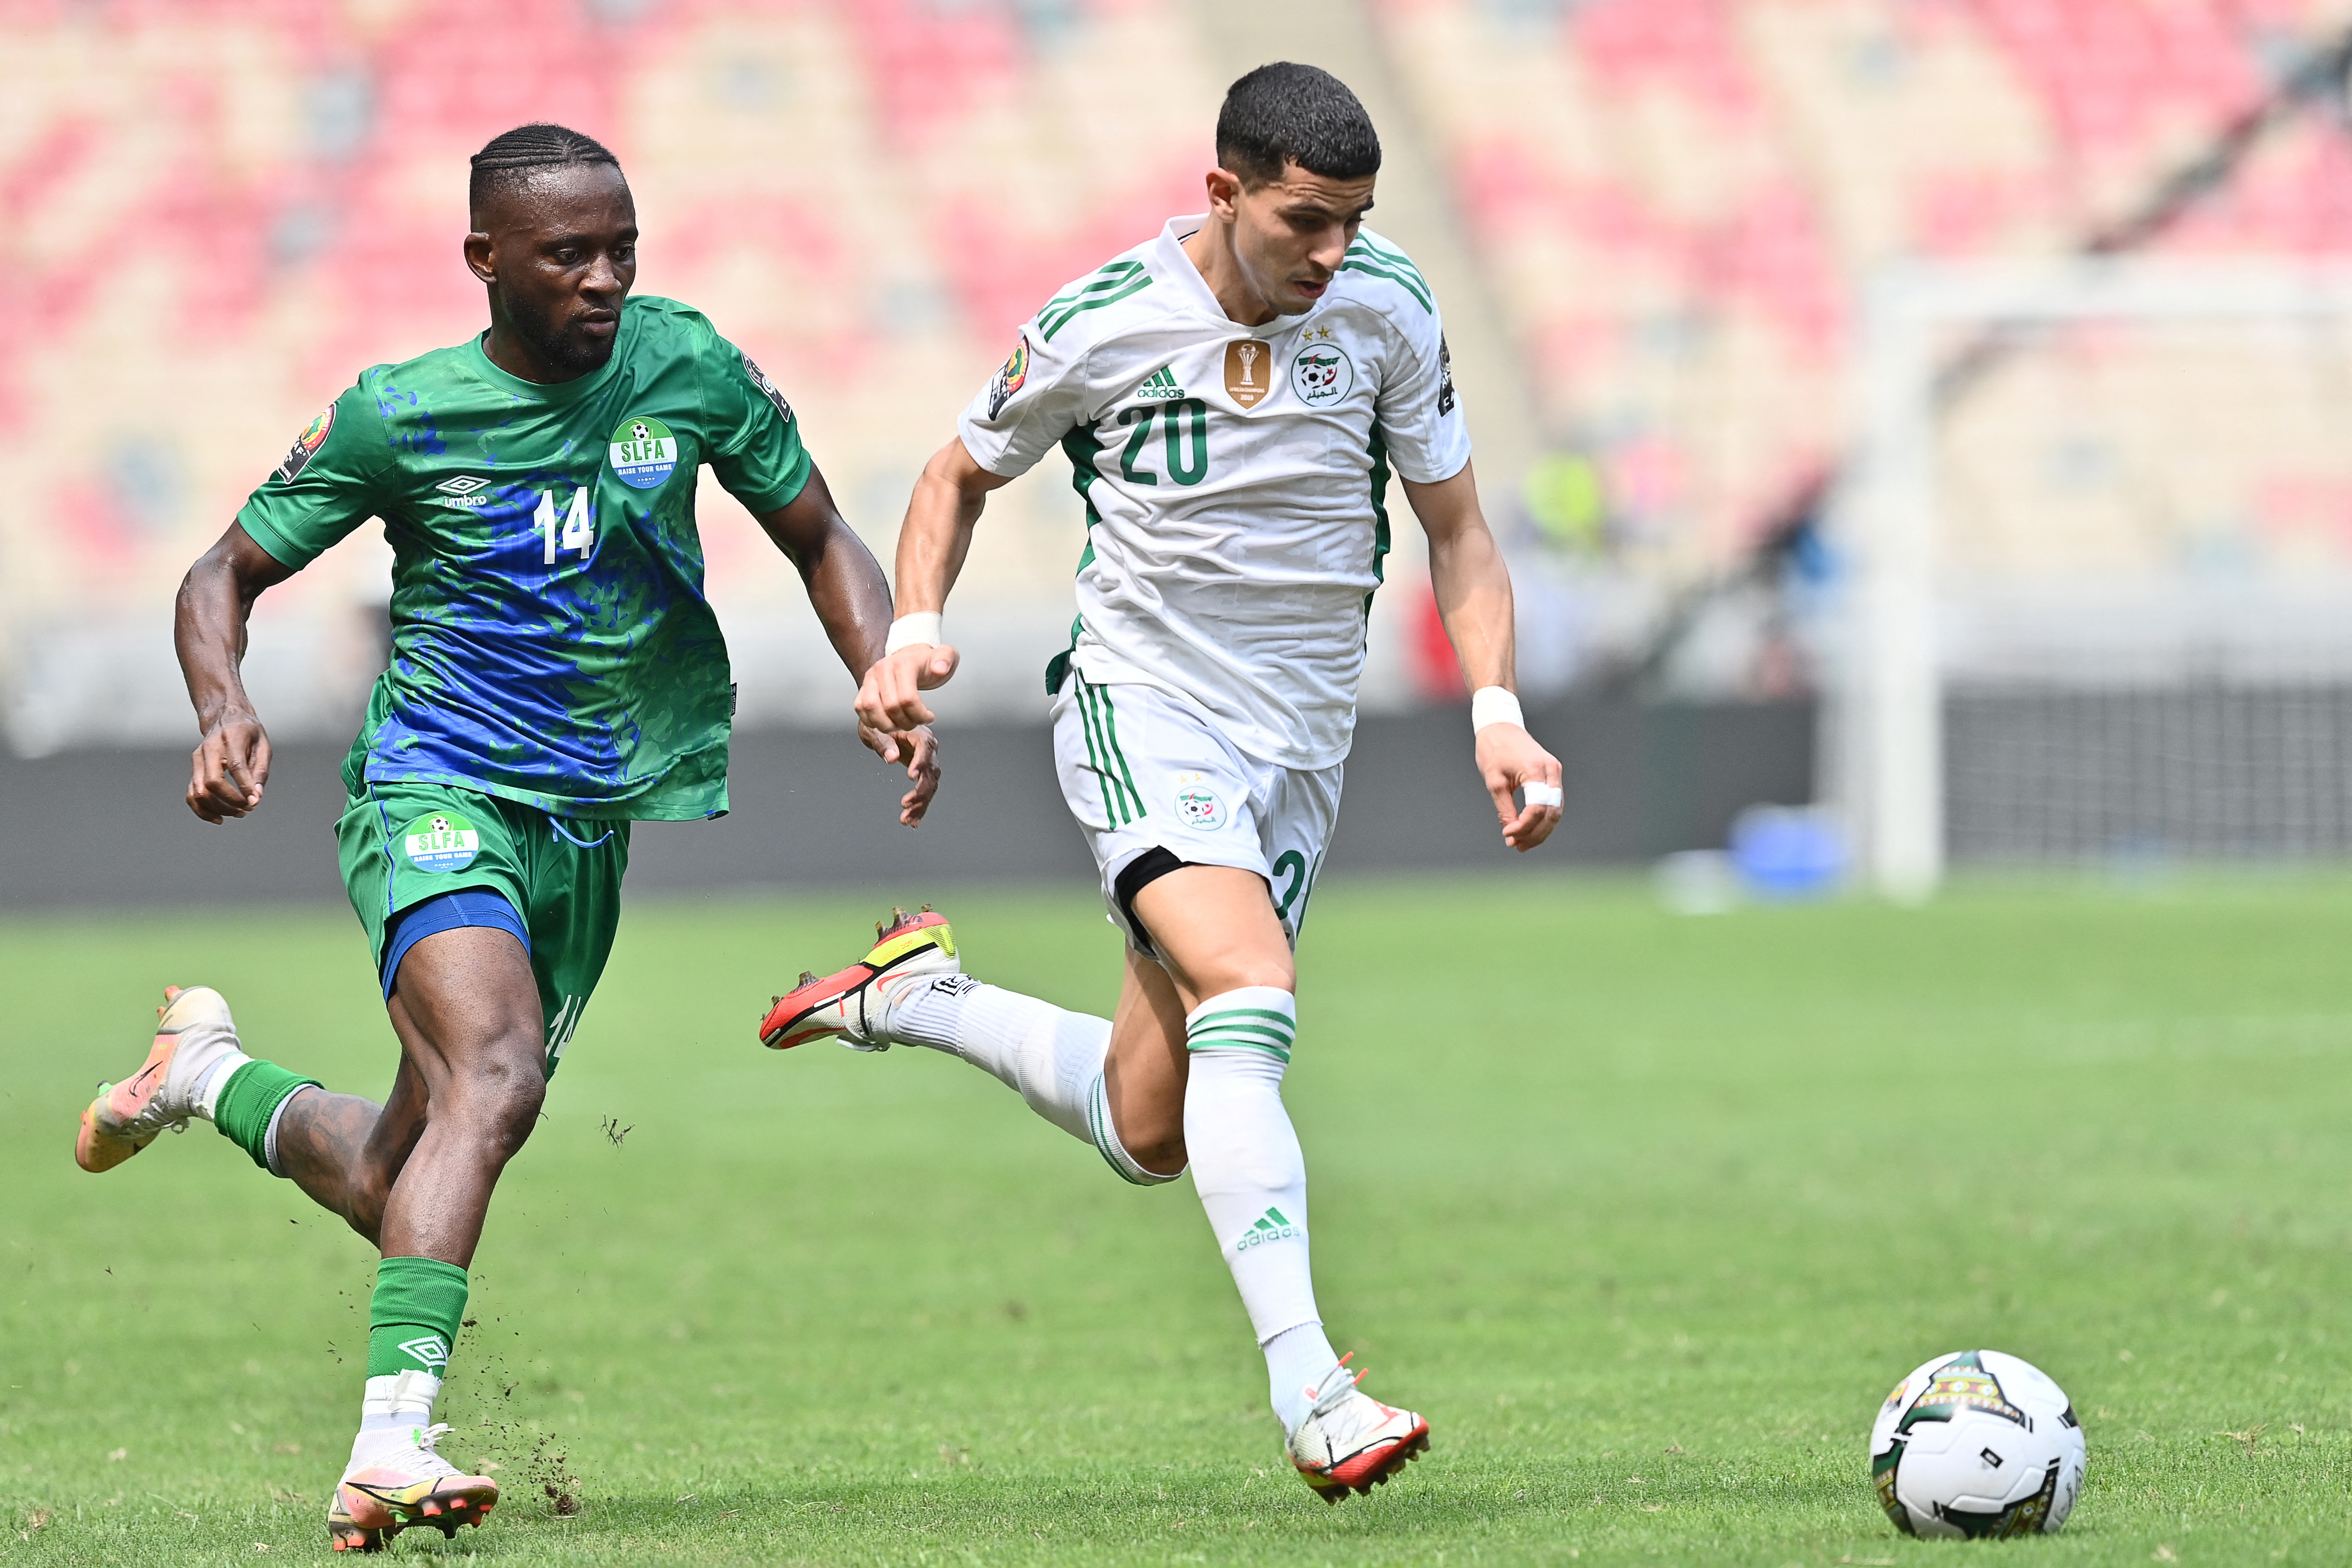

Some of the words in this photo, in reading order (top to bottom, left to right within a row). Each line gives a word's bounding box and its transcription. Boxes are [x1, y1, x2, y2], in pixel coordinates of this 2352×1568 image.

[1138, 386, 1185, 398] adidas
[621, 439, 665, 462] SLFA
[1117, 398, 1208, 486] 20
[444, 495, 487, 507] umbro
[533, 486, 593, 564] 14
[419, 832, 465, 851] SLFA
[1237, 1227, 1300, 1251] adidas
